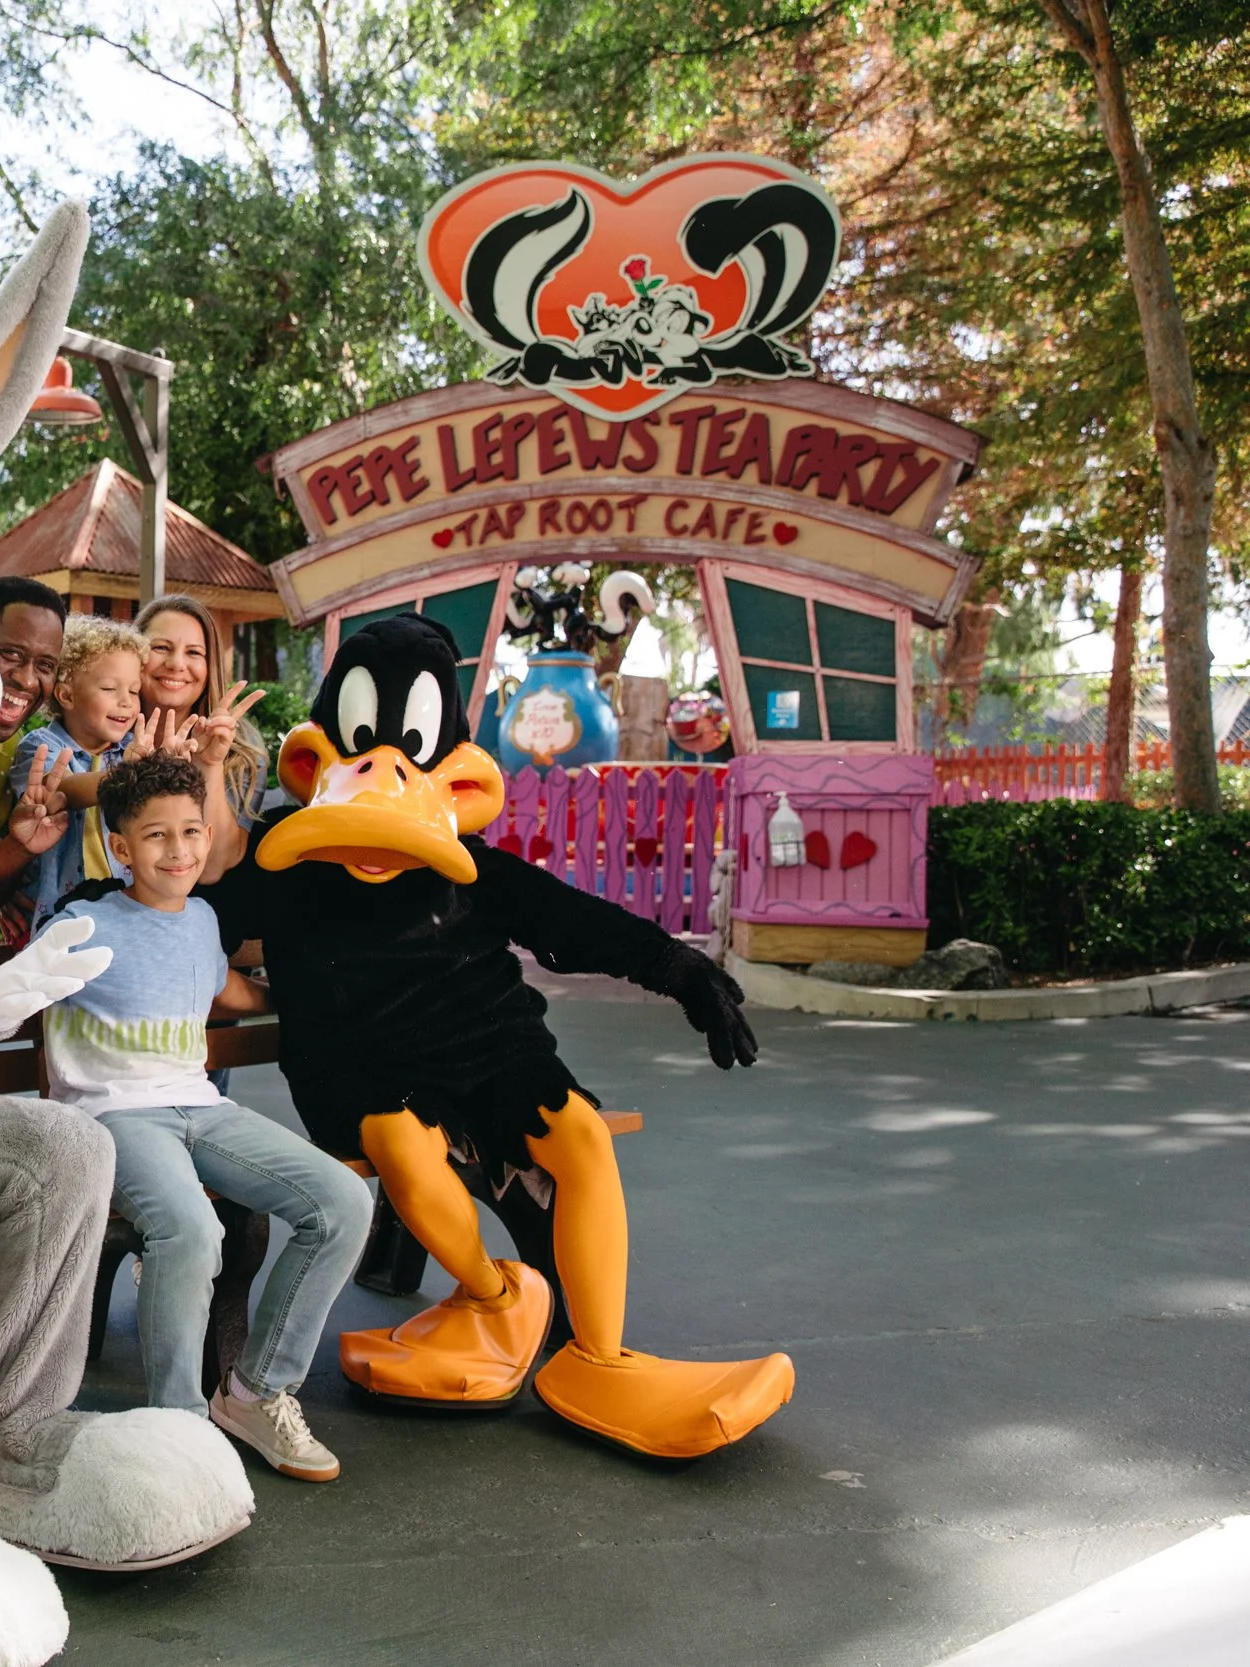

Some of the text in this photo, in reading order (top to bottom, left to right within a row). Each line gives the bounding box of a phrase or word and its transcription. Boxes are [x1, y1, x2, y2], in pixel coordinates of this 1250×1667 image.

[307, 435, 431, 526] PEPE
[668, 404, 773, 485] TEA
[774, 423, 941, 516] PARTY
[454, 494, 770, 547] TAP ROOT CAFE
